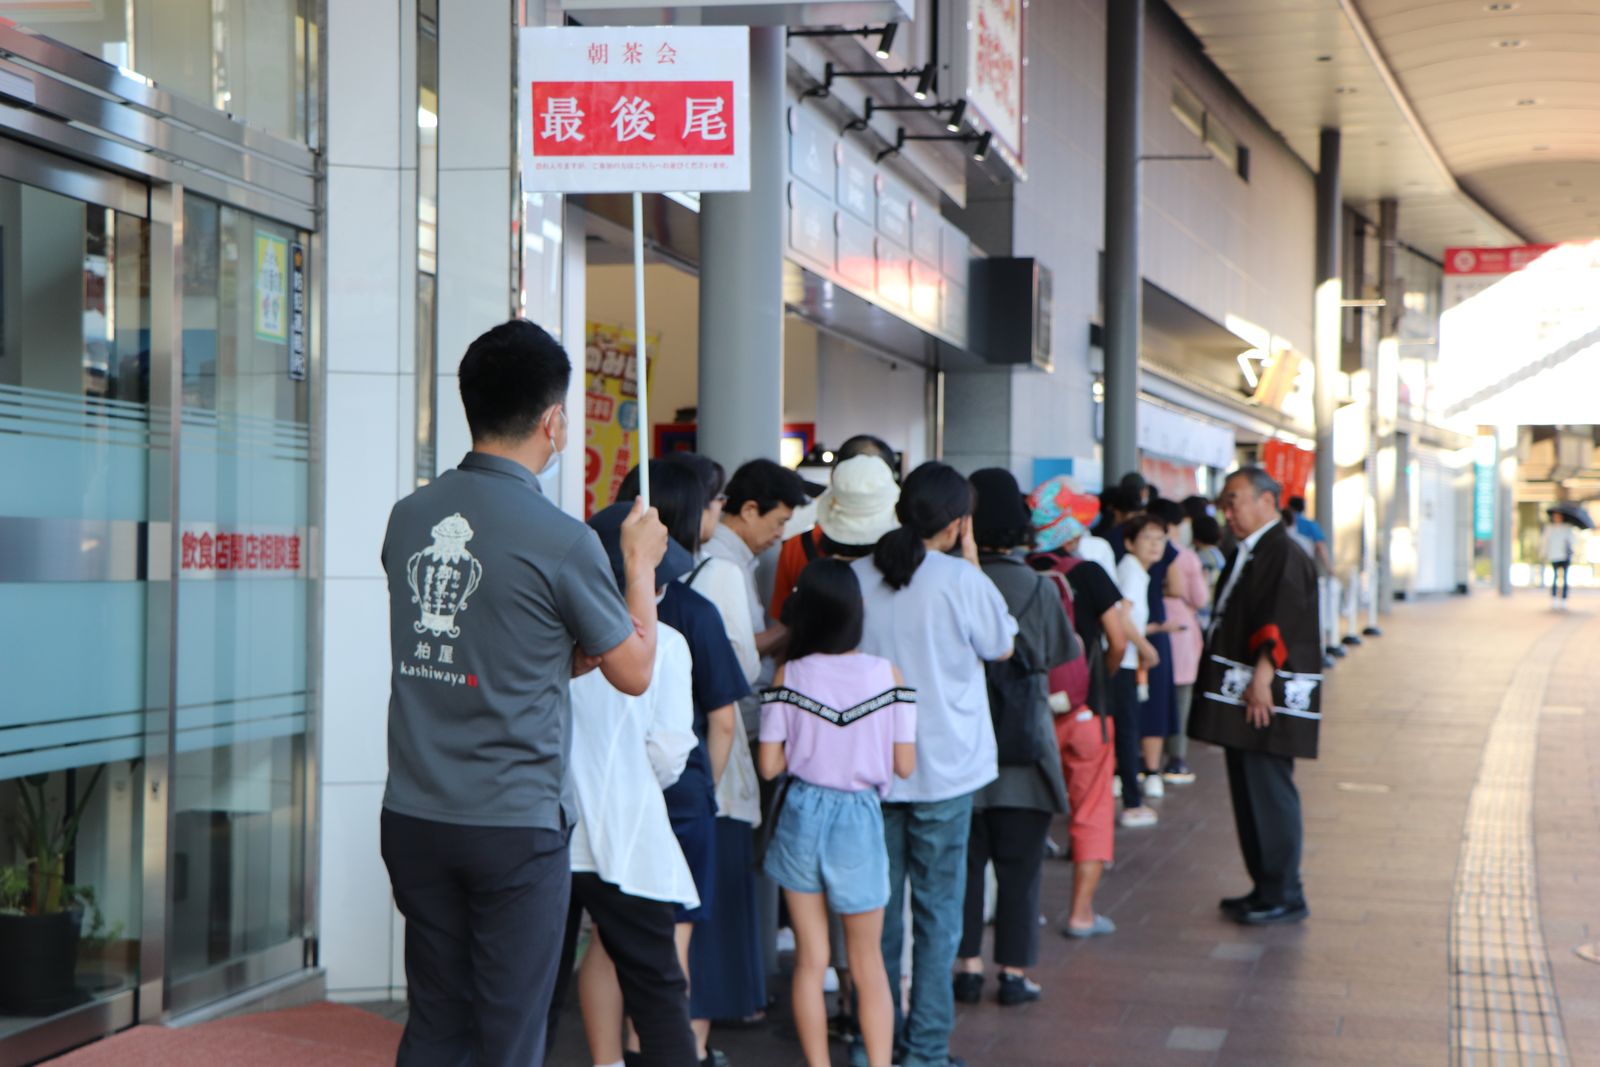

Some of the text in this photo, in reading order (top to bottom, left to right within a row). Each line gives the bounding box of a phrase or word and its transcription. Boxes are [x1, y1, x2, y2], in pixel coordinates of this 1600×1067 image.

[587, 42, 677, 65] 朝茶会
[539, 95, 728, 143] 最後尾
[414, 641, 455, 664] 柏屋
[400, 662, 466, 686] kashiwaya
